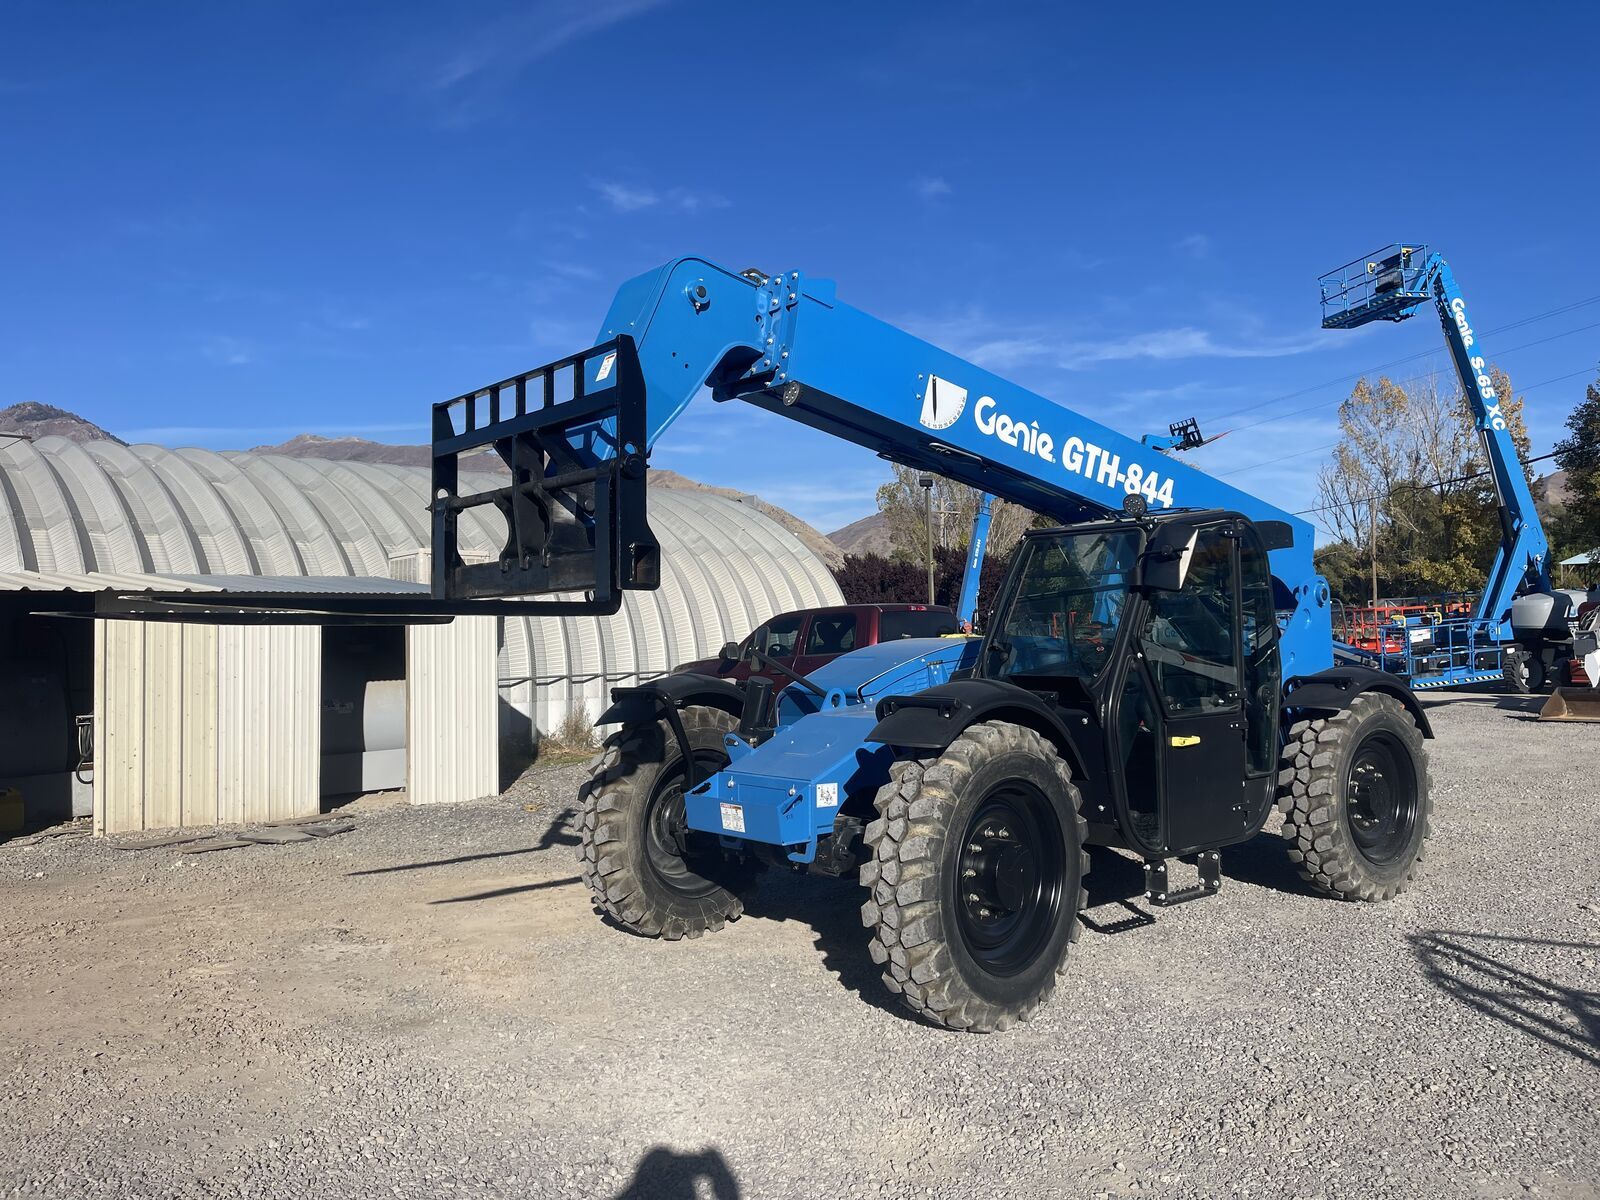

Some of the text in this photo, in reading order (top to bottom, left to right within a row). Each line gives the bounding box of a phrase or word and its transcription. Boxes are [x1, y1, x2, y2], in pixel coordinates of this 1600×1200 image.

[1451, 297, 1506, 431] Genie S-65 XC
[974, 396, 1175, 509] Genie GTH-844
